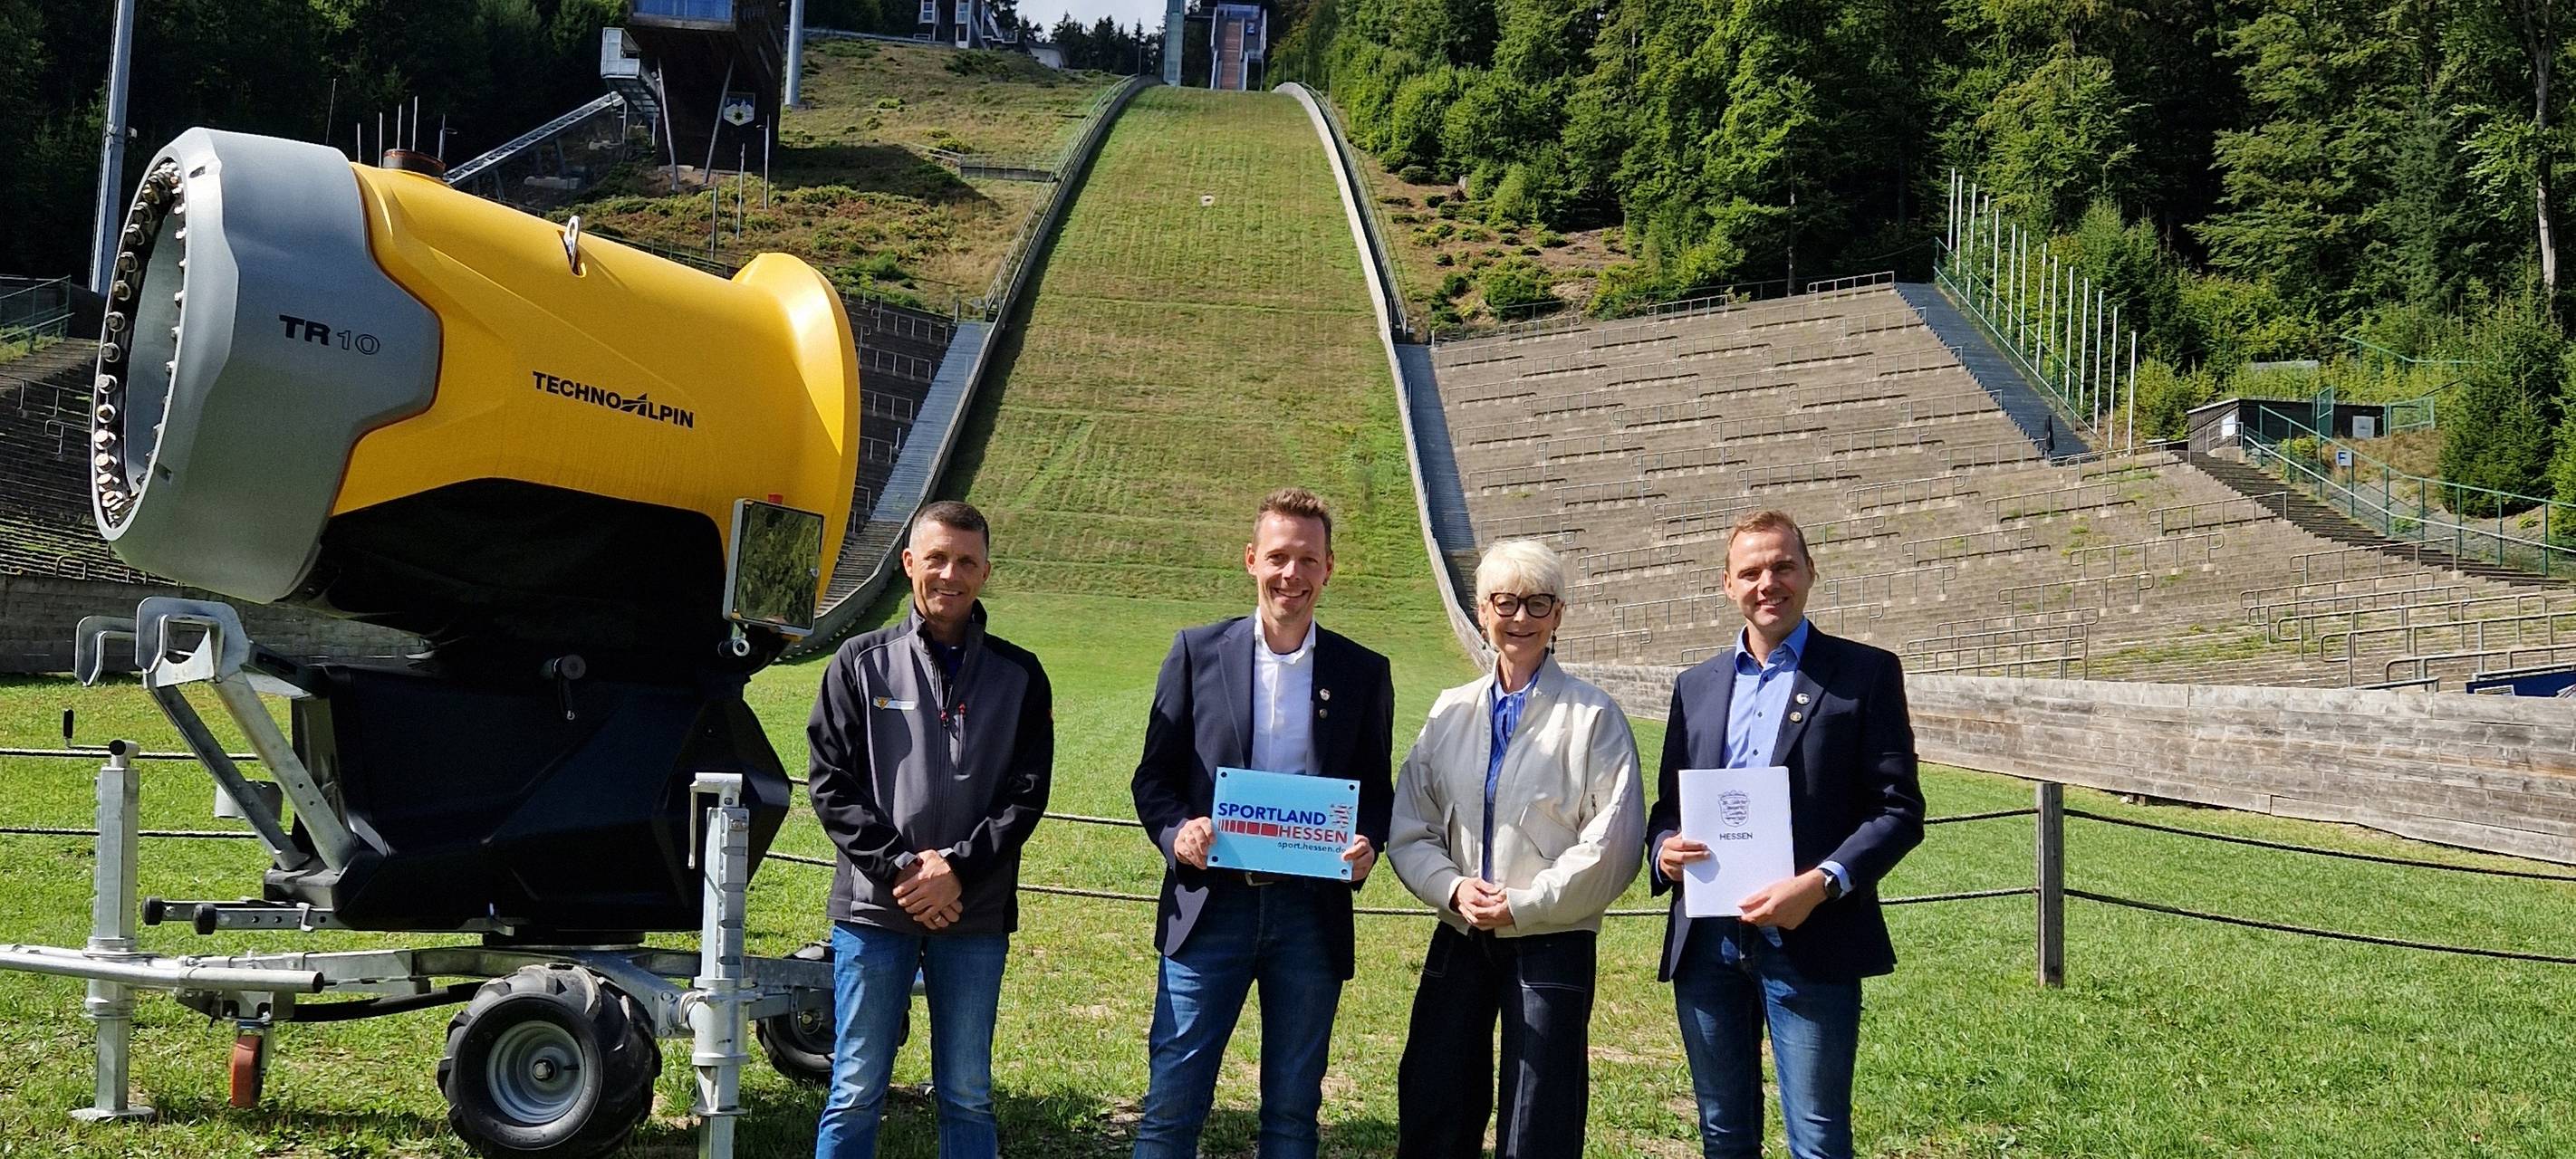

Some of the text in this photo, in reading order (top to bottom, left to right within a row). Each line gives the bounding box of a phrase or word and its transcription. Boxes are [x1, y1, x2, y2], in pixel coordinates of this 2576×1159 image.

[279, 314, 380, 355] TR 10
[533, 370, 695, 429] TECHNOALPIN
[2338, 451, 2347, 464] F
[1217, 802, 1326, 826] SPORTLAND
[1279, 825, 1348, 844] HESSEN
[1719, 832, 1754, 840] HESSEN
